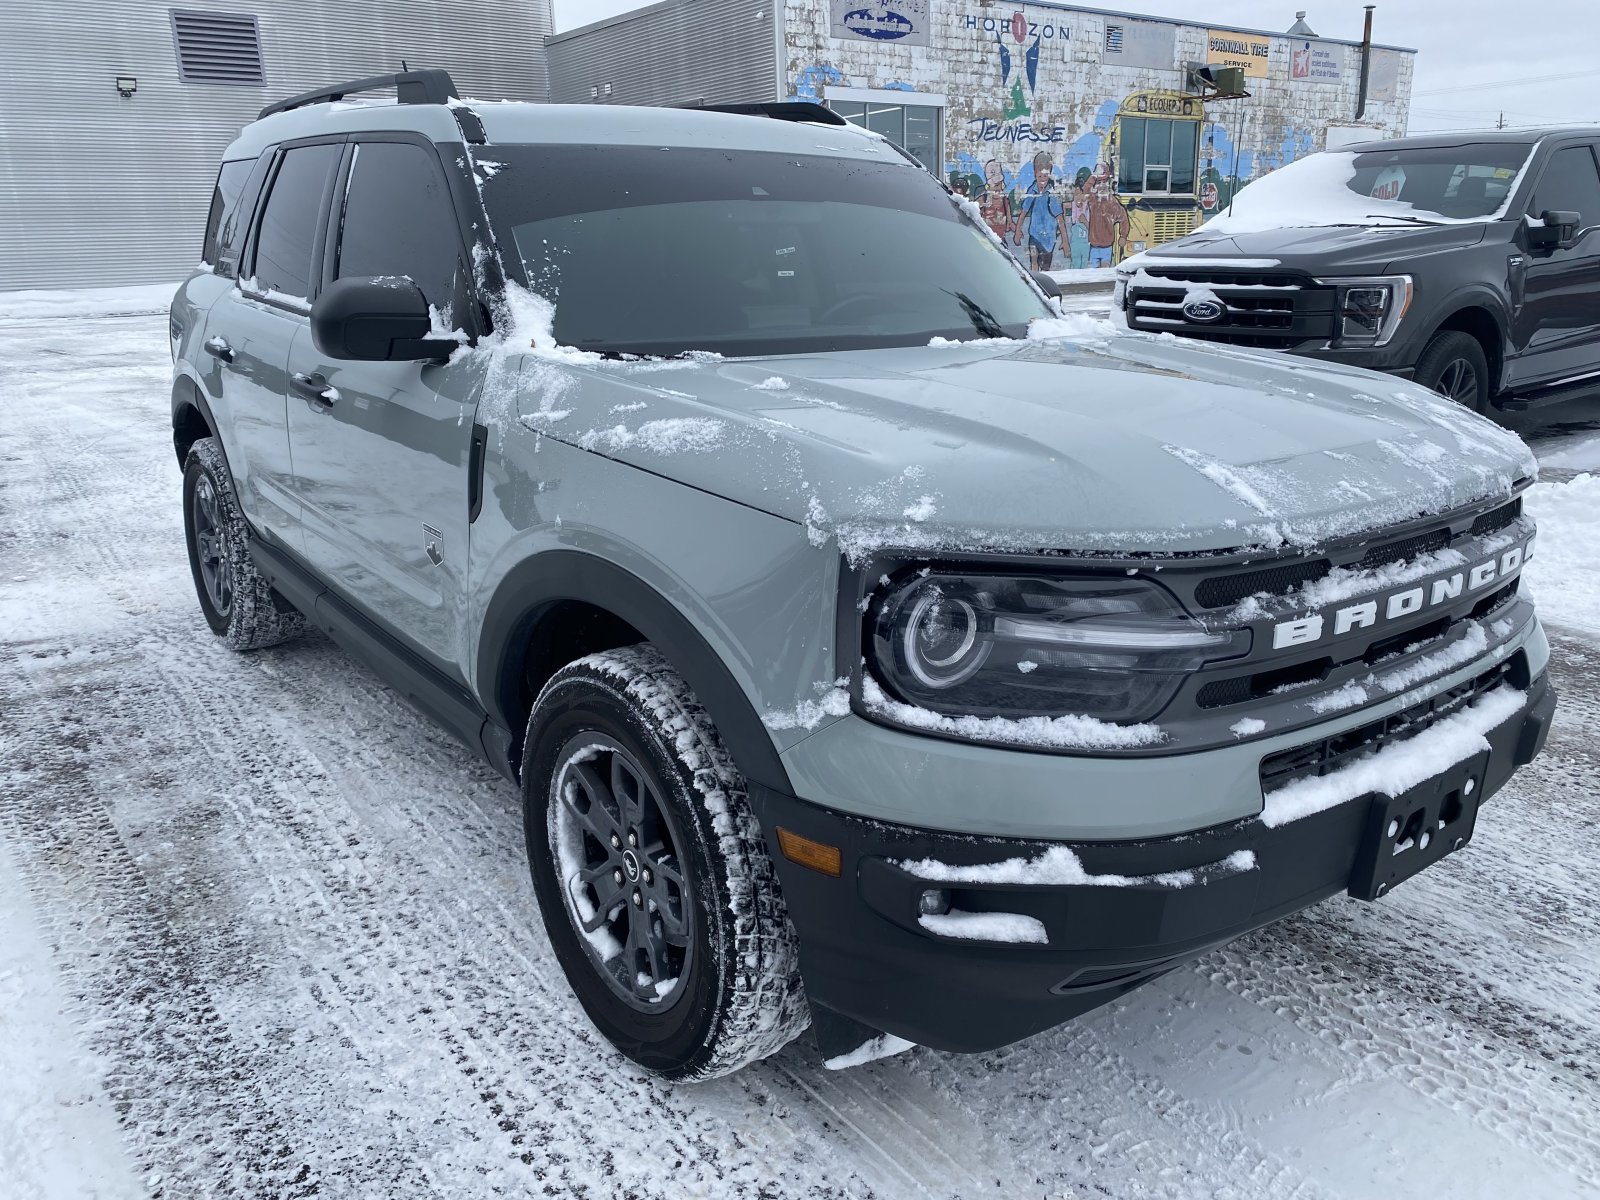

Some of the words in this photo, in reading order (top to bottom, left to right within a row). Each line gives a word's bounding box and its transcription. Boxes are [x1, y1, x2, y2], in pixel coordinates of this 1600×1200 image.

[966, 14, 1070, 40] HORIZON
[1210, 38, 1249, 55] CORNWALL
[1250, 43, 1269, 57] TIRE
[1223, 60, 1253, 68] SERVICE
[966, 117, 1066, 143] JEUNESSE
[1372, 180, 1399, 200] SOLD
[1191, 304, 1212, 316] Ford
[1273, 547, 1522, 649] BRONCO
